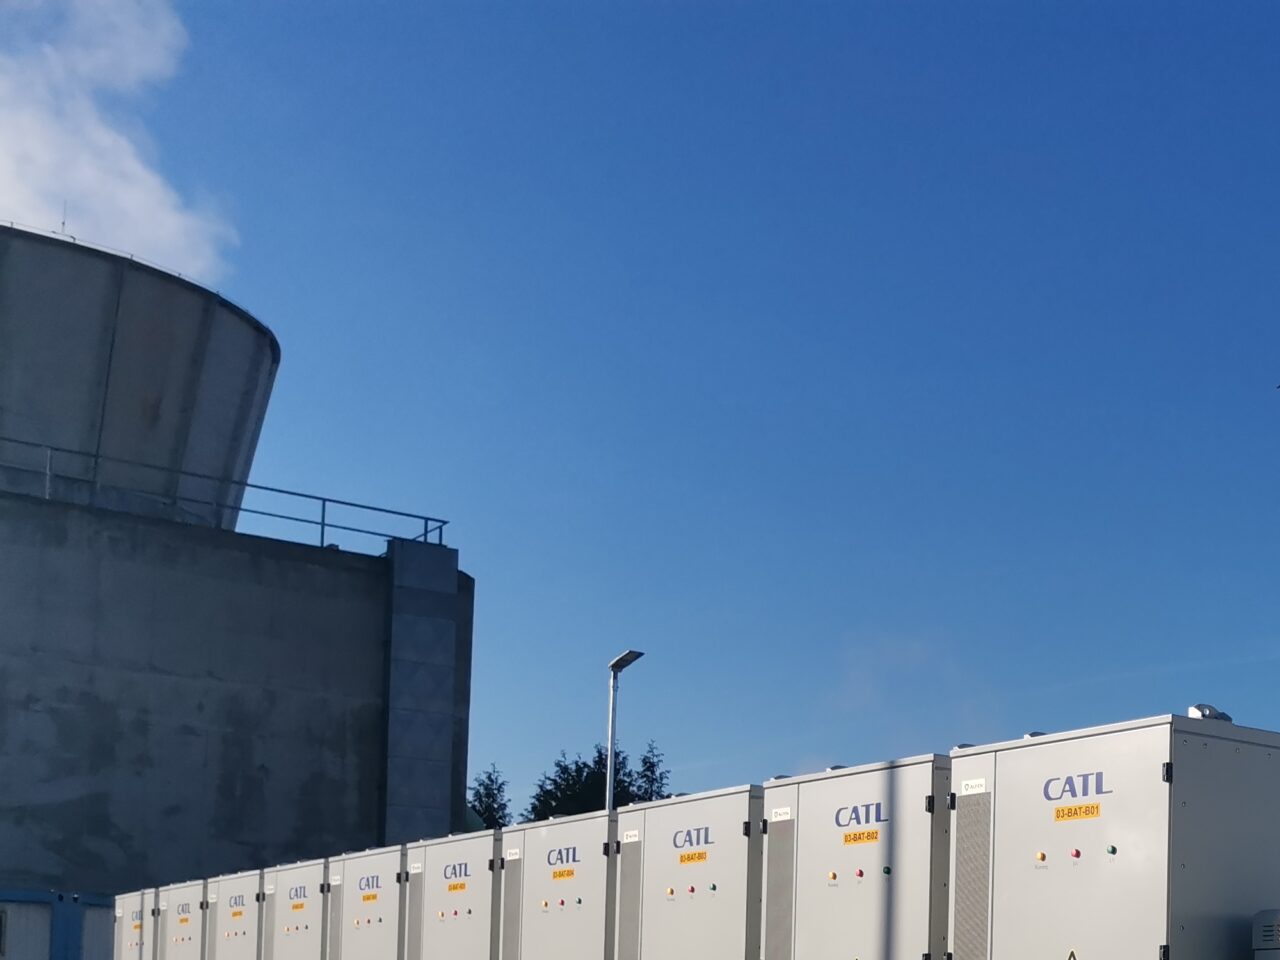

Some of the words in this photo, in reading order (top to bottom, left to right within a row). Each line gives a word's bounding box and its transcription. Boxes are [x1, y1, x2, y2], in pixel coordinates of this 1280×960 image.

[1043, 771, 1113, 801] CATL
[835, 802, 889, 827] CATL
[1056, 804, 1099, 819] 03-BAT-B01
[672, 826, 715, 849] CATL
[547, 846, 581, 866] CATL
[443, 862, 471, 880] CATL
[359, 875, 382, 891] CATL
[229, 895, 245, 908] CATL
[289, 886, 307, 900] CATL
